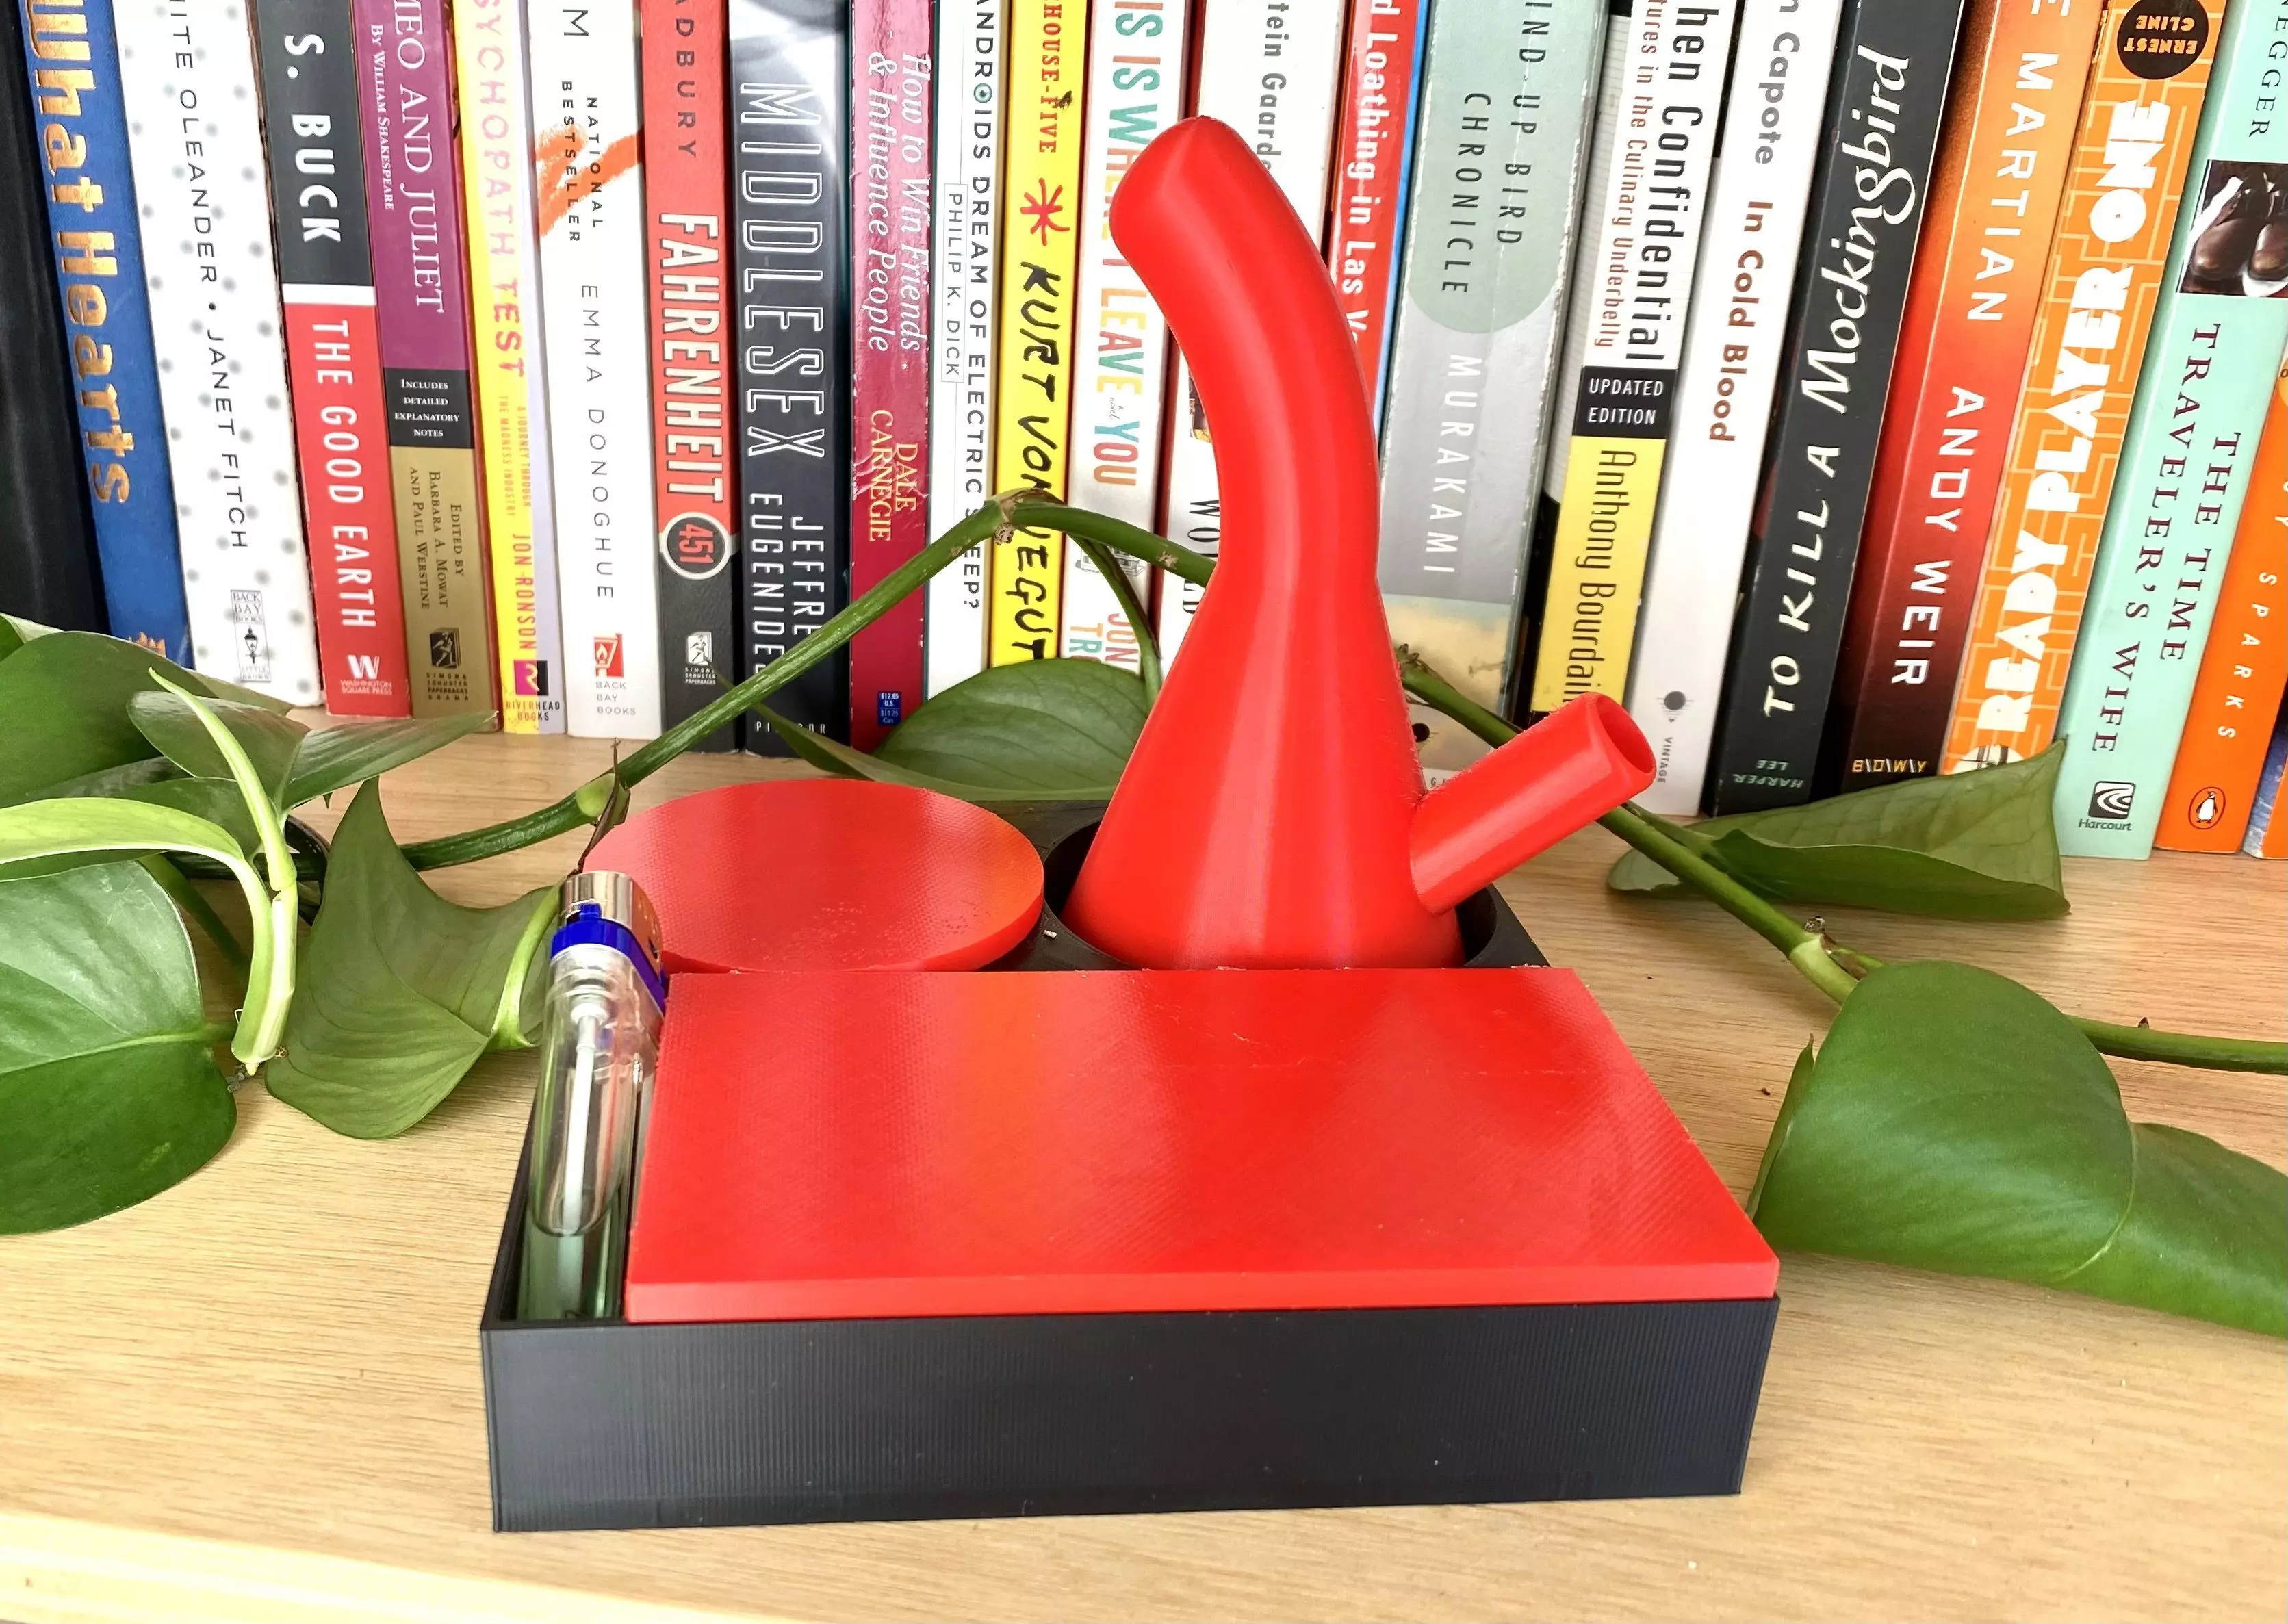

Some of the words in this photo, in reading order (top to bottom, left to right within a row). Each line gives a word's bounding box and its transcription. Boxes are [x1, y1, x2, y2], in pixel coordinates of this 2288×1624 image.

[169, 0, 194, 68] ITE
[370, 23, 385, 47] BY
[1114, 1, 1164, 37] IS
[1263, 2, 1290, 57] tein
[1667, 7, 1720, 81] hen
[2124, 38, 2198, 55] ERNEST
[2135, 15, 2195, 31] CLINE
[284, 34, 325, 80] S.
[372, 49, 388, 114] WILLIAM
[676, 0, 697, 158] DBURY
[867, 51, 898, 77] &
[901, 51, 931, 125] How
[1038, 0, 1062, 153] HOUSE-FIVE
[1112, 55, 1161, 90] IS
[1636, 66, 1660, 83] in
[2248, 0, 2288, 138] EGGER
[25, 0, 104, 214] What
[399, 83, 433, 174] AND
[1347, 32, 1398, 180] Loathing
[1630, 96, 1654, 127] the
[1754, 31, 1801, 165] Capote
[292, 114, 342, 244] BUCK
[378, 114, 395, 211] SHAKESPEARE
[561, 81, 580, 242] BESTSELLER
[587, 96, 604, 229] NATIONAL
[867, 88, 898, 237] Influence
[901, 133, 924, 164] to
[1610, 139, 1648, 227] Culinary
[179, 88, 218, 283] OLEANDER
[901, 177, 930, 235] Win
[1348, 196, 1381, 224] in
[1441, 92, 1491, 293] CHRONICLE
[1496, 163, 1532, 245] BIRD
[1743, 201, 1774, 233] In
[1966, 52, 2059, 322] MARTIAN
[400, 183, 445, 314] JULIET
[947, 193, 963, 273] PHILIP
[971, 176, 990, 283] DREAM
[1625, 105, 1704, 361] Confidential
[1801, 44, 1916, 415] Mockingbird
[739, 83, 825, 458] MIDDLESEX
[860, 248, 897, 353] People
[900, 243, 930, 352] Friends
[947, 286, 962, 307] K.
[1341, 241, 1376, 294] Las
[1594, 237, 1634, 349] Underbelly
[1727, 249, 1764, 328] Cold
[312, 320, 354, 385] THE
[491, 276, 526, 379] TEST
[581, 285, 603, 383] EMMA
[946, 320, 960, 376] DICK
[969, 299, 988, 339] OF
[1019, 261, 1062, 402] KURT
[1097, 287, 1147, 396] LEAVE
[57, 231, 135, 504] Hearts
[207, 329, 236, 437] JANET
[401, 378, 449, 389] INCLUDES
[658, 213, 724, 503] FAHRENHEIT
[1588, 377, 1664, 397] UPDATED
[1708, 344, 1749, 441] Blood
[394, 412, 460, 422] EXPLANATORY
[404, 396, 448, 405] DETAILED
[413, 429, 444, 437] NOTES
[499, 395, 509, 413] THE
[964, 353, 986, 493] ELECTRIC
[1588, 407, 1657, 426] EDITION
[1976, 529, 2069, 732] READY
[2025, 266, 2134, 513] PLAYER
[2089, 99, 2172, 243] ONE
[320, 405, 365, 505] GOOD
[500, 417, 512, 465] MADNESS
[517, 415, 530, 459] JOURNEY
[1093, 420, 1141, 487] YOU
[1423, 353, 1484, 574] MURAKAMI
[1806, 444, 1841, 478] A
[1925, 386, 1985, 532] ANDY
[2124, 323, 2222, 619] TRAVELER'S
[221, 452, 248, 548] FITCH
[410, 466, 421, 496] AND
[429, 470, 442, 533] BARBARA
[504, 469, 516, 517] INDUSTRY
[587, 408, 614, 599] DONOGHUE
[869, 409, 894, 543] CARNEGIE
[894, 442, 919, 513] DALE
[1574, 448, 1637, 570] Anthony
[2194, 432, 2242, 525] THE
[413, 501, 424, 536] PAUL
[435, 537, 446, 554] A.
[450, 504, 463, 555] EDITED
[512, 533, 532, 566] JON
[678, 522, 715, 567] 451
[1004, 415, 1058, 660] VOEGUT
[332, 524, 376, 628] EARTH
[416, 541, 430, 610] WERSTINE
[436, 558, 449, 608] MOWAT
[454, 559, 465, 578] BY
[1777, 498, 1831, 632] KILL
[515, 577, 537, 650] RONSON
[1891, 559, 1953, 686] WEIR
[2159, 547, 2212, 661] TIME
[1068, 623, 1103, 663] TR
[2217, 571, 2278, 739] SPARKS
[339, 679, 392, 687] WASHINGTON
[342, 686, 370, 694] SQUARE
[372, 687, 393, 696] PRESS
[506, 700, 561, 711] RIVERHEAD
[518, 712, 550, 721] BOOKS
[595, 681, 627, 690] BACK
[596, 693, 618, 702] BAY
[597, 706, 637, 716] BOOKS
[1763, 655, 1801, 718] TO
[2092, 641, 2142, 752] WIFE
[1657, 736, 1673, 783] VINTAGE
[1733, 773, 1805, 788] HARPER
[1756, 760, 1790, 771] LEE
[2078, 818, 2133, 832] Harcourt
